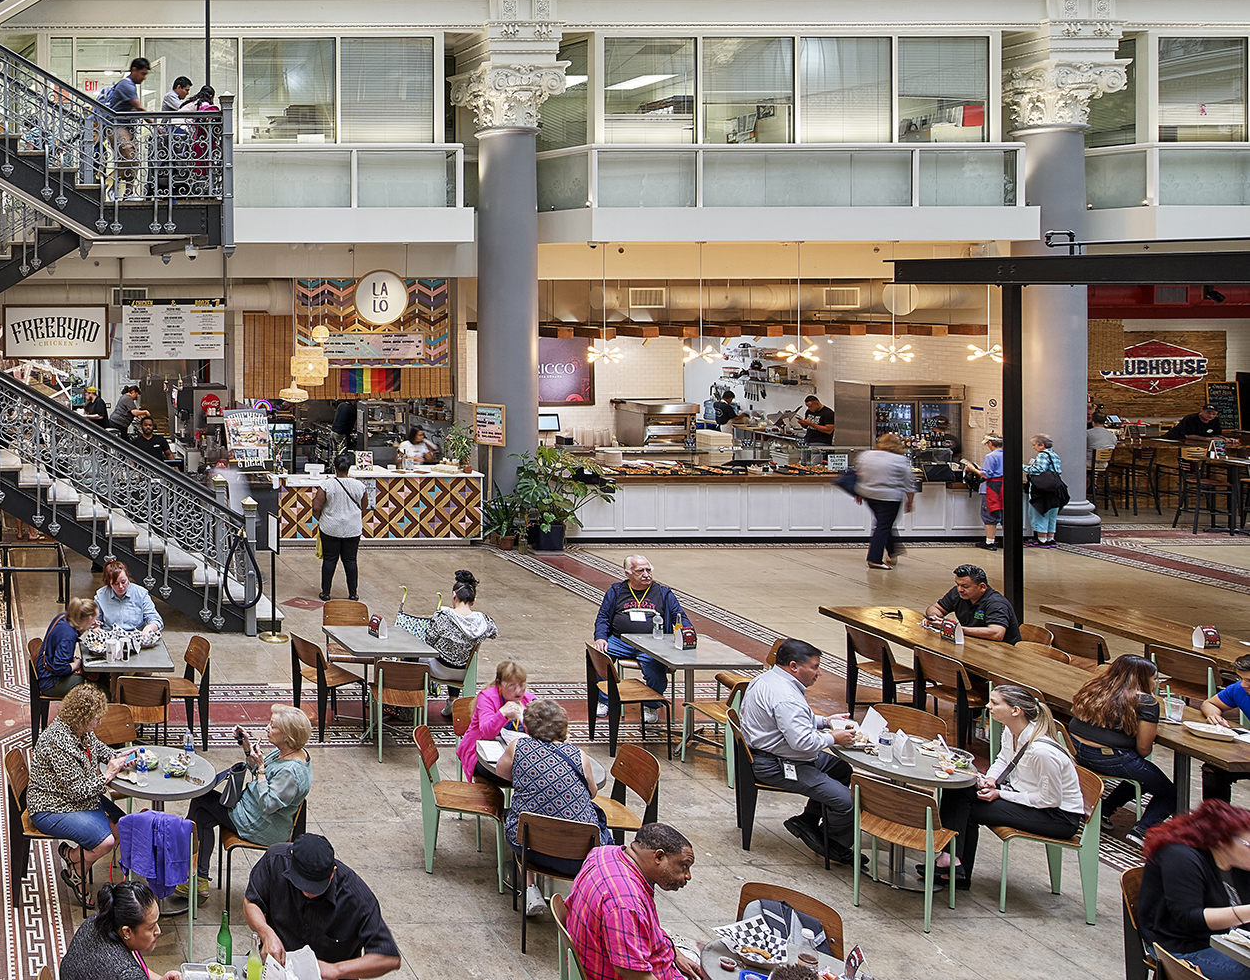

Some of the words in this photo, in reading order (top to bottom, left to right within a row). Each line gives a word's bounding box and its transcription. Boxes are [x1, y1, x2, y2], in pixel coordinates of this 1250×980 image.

[84, 80, 99, 91] EXIT
[372, 281, 389, 297] LA
[372, 299, 389, 314] LO
[10, 316, 101, 345] FREEBYRD
[1100, 359, 1208, 376] UBHOUSE
